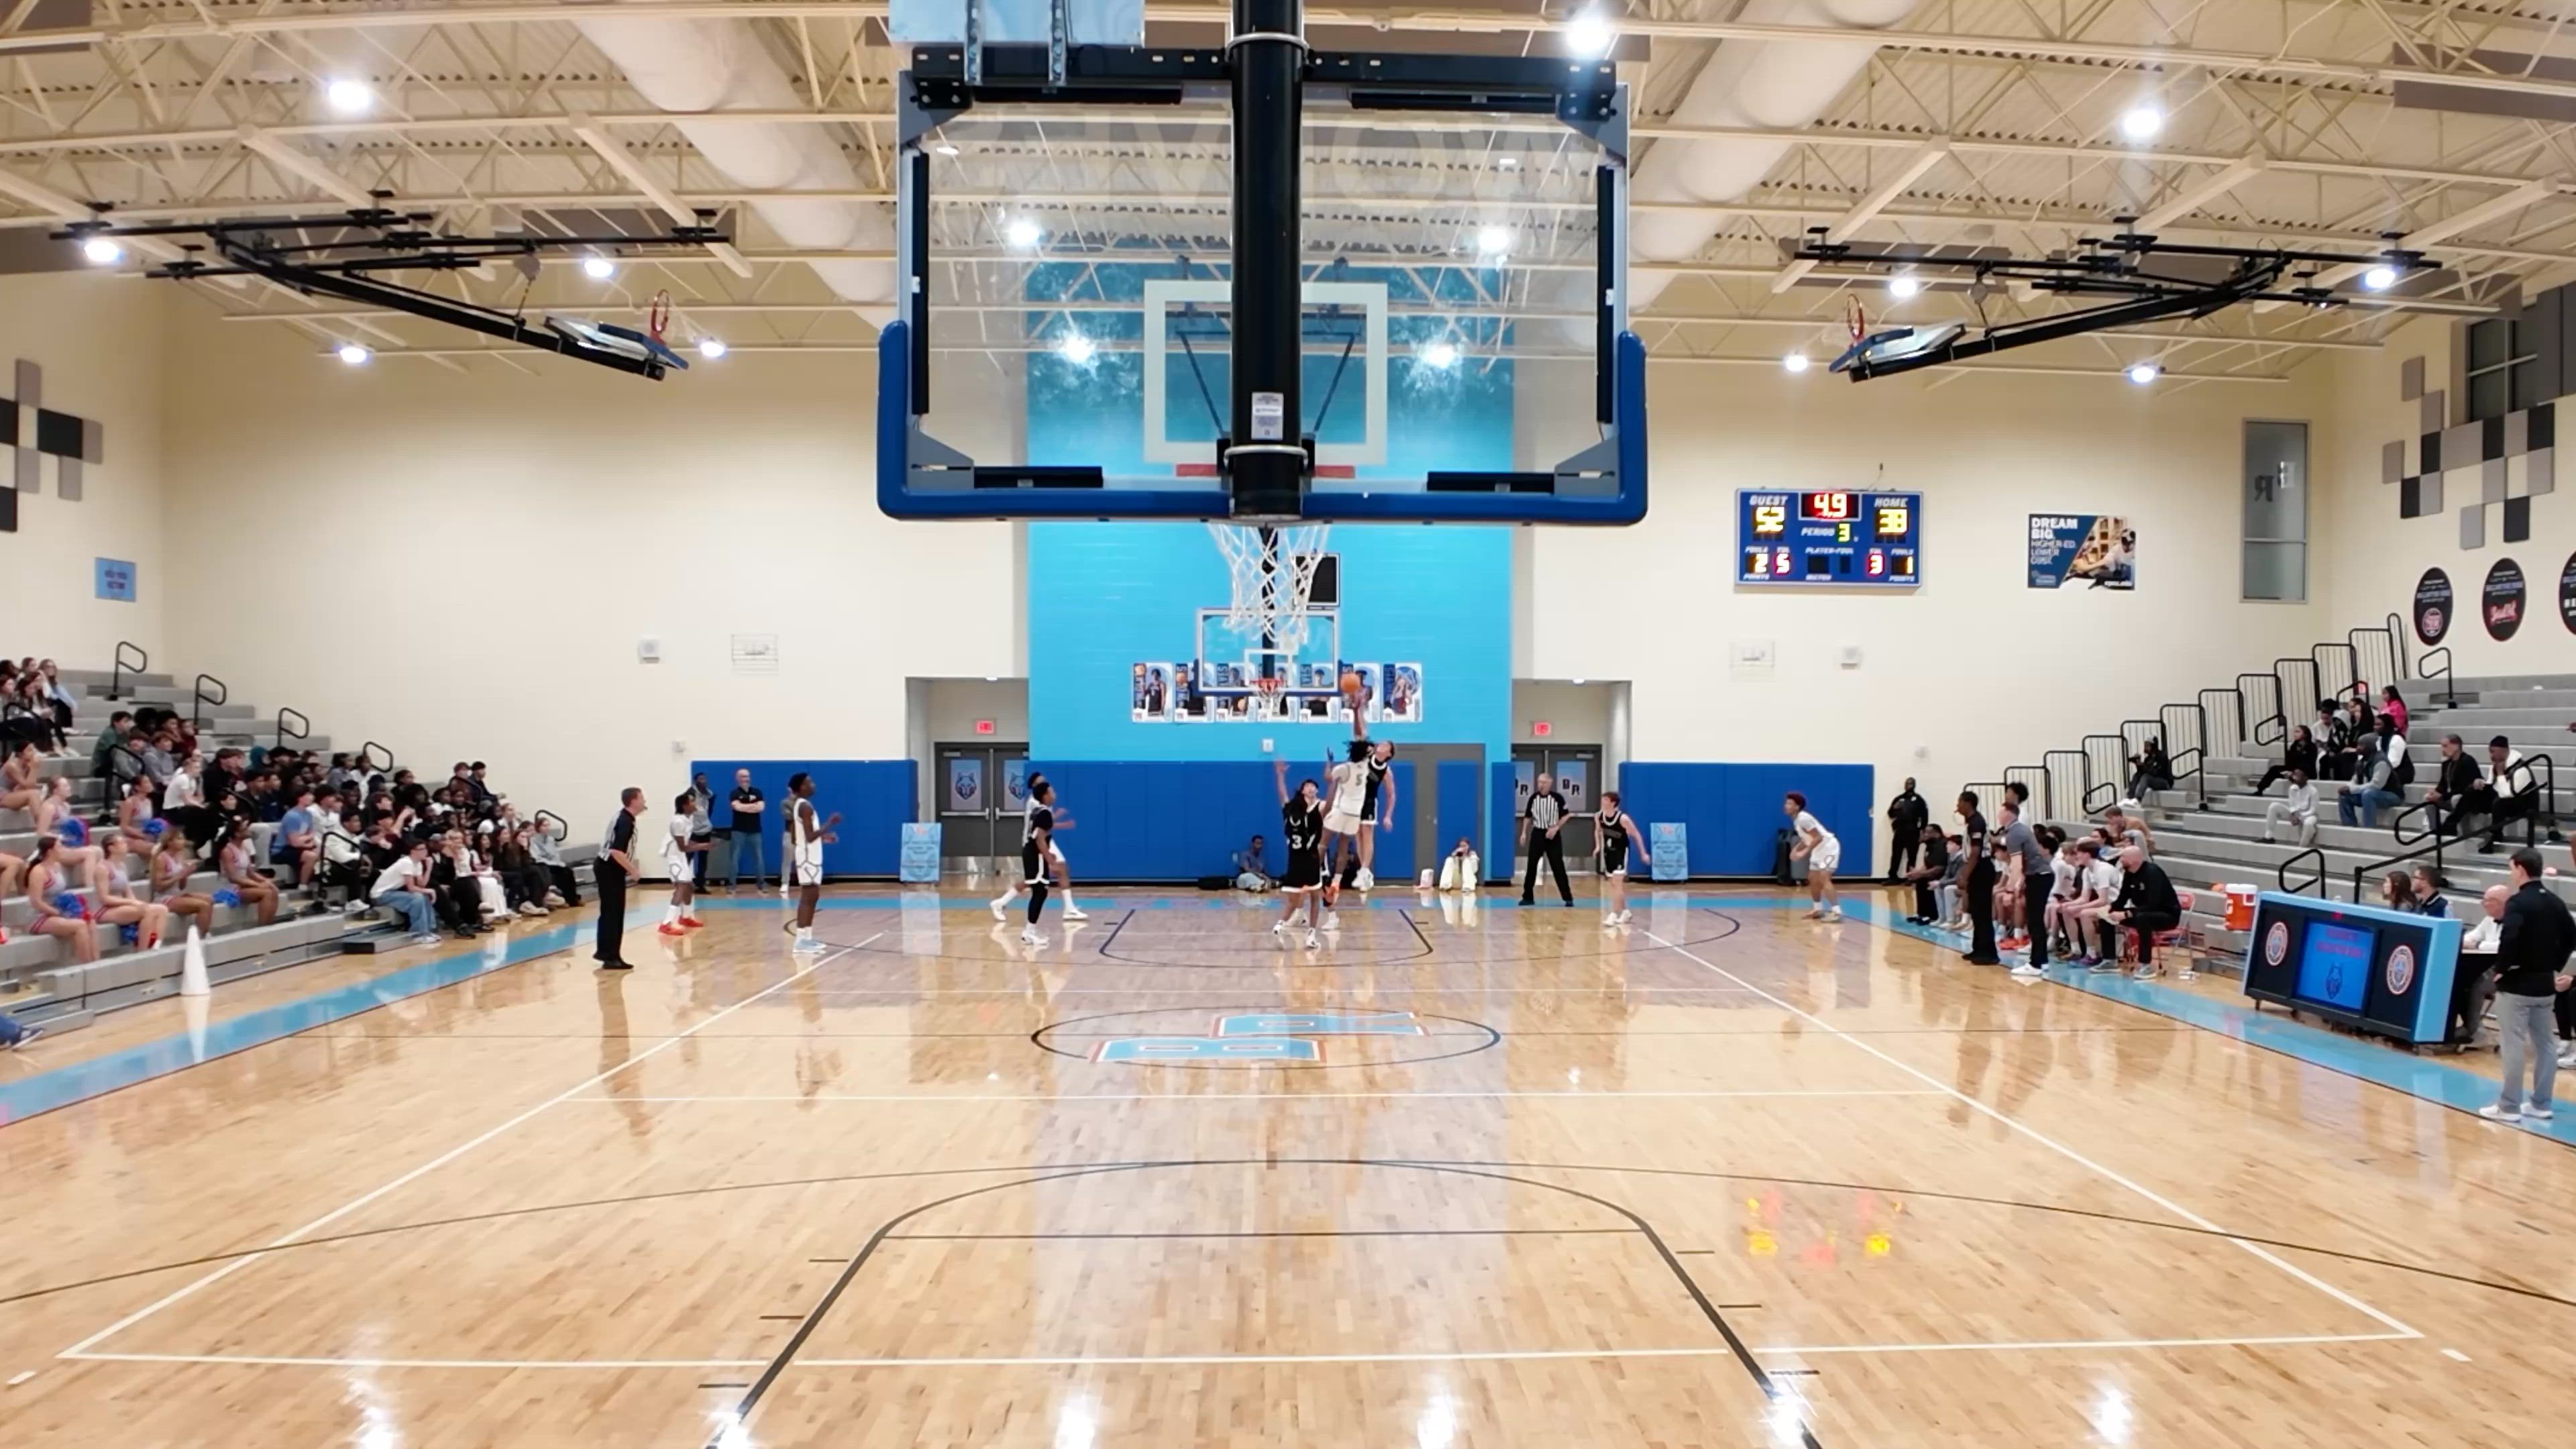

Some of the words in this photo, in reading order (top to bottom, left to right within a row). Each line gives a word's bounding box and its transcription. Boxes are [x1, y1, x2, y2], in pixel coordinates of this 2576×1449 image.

[1749, 496, 1788, 506] GUEST
[1814, 494, 1847, 519] 49
[1874, 498, 1908, 508] HOME
[2031, 518, 2078, 529] DREAM
[1801, 527, 1836, 537] PERIOD
[1838, 523, 1850, 542] 3
[1776, 553, 1790, 574] 5
[1870, 555, 1884, 574] 3
[1906, 555, 1914, 574] 1
[1355, 773, 1362, 786] 5
